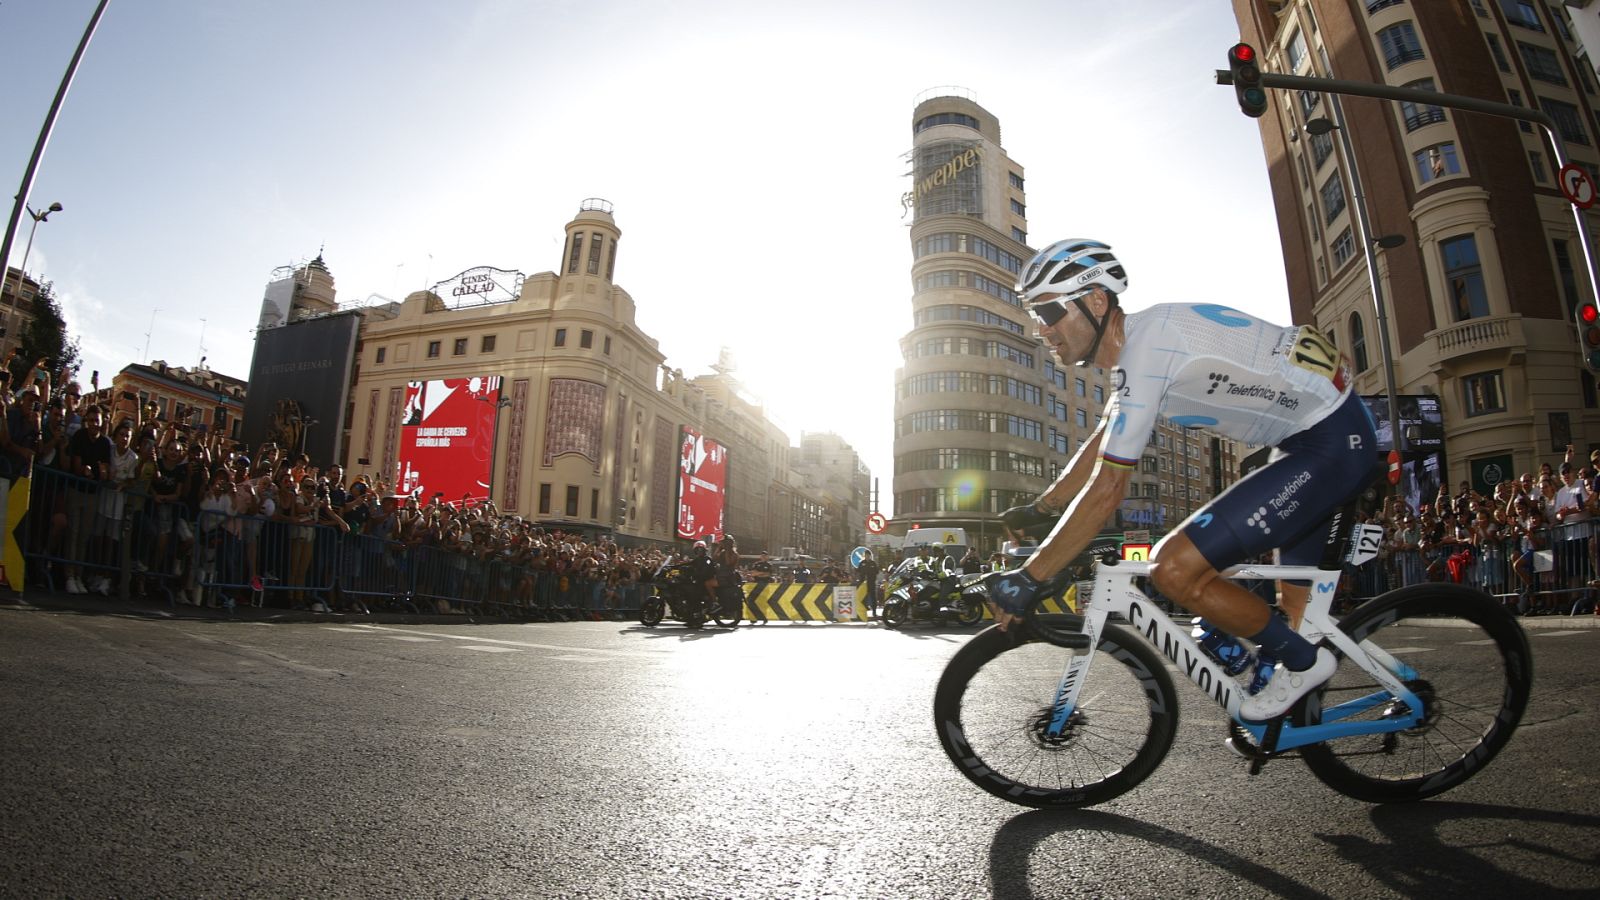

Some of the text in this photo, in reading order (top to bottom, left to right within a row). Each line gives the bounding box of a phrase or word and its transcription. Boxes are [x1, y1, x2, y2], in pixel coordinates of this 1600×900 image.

[461, 274, 489, 284] CINES
[1081, 268, 1101, 282] ABUS
[452, 282, 495, 297] CALLAO
[1295, 326, 1338, 371] 12
[1226, 383, 1300, 411] Telefónica Tech
[630, 410, 642, 521] CALLAO
[1269, 469, 1313, 511] Telefónica
[1277, 499, 1301, 521] Tech
[946, 534, 956, 543] A
[1327, 512, 1343, 545] CANYO
[1358, 528, 1383, 556] 121
[1129, 601, 1231, 710] CANYON
